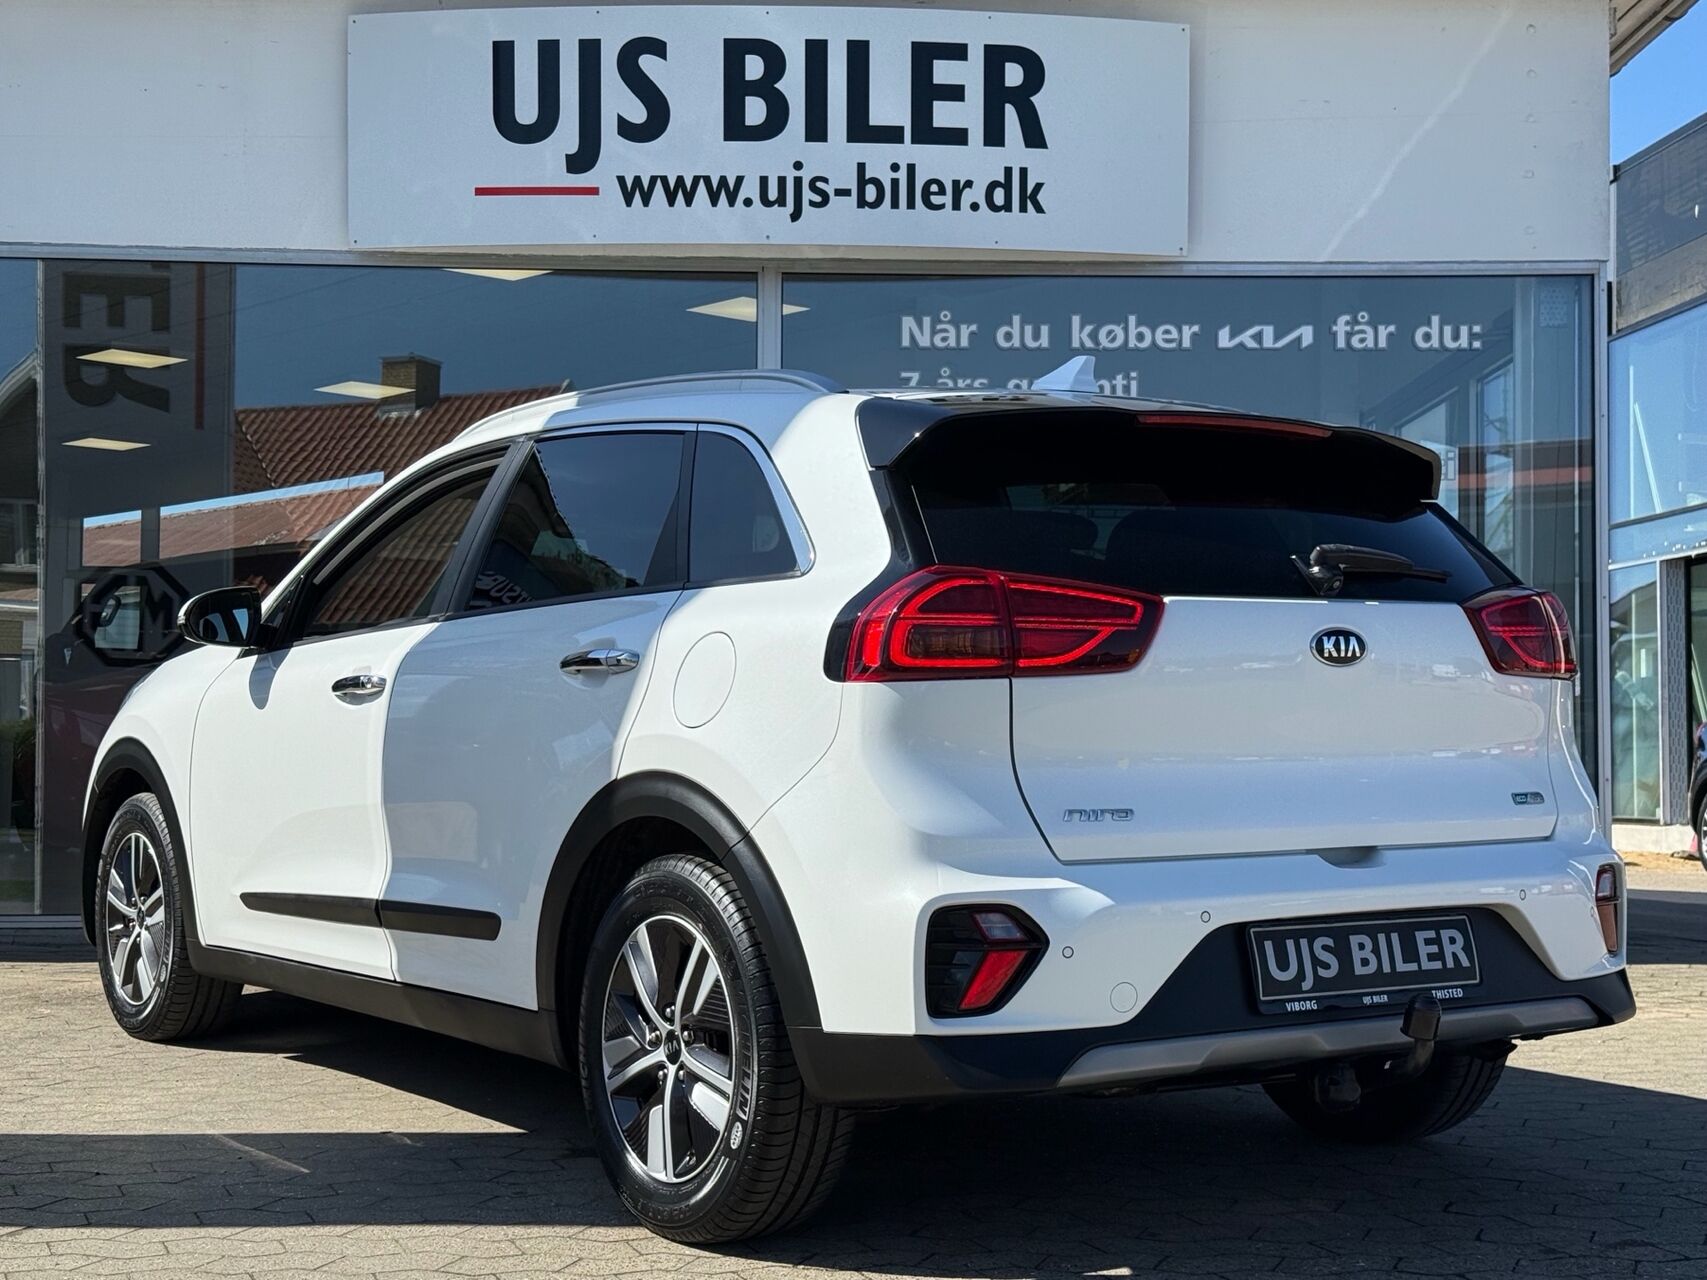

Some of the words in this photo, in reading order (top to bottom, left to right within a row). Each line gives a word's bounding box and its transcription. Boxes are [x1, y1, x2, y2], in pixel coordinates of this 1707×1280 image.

[492, 36, 671, 175] UJS
[723, 37, 1049, 150] BILER
[616, 160, 1046, 223] www.ujs-biler.dk
[900, 311, 977, 348] Når
[995, 315, 1049, 348] du
[1071, 315, 1199, 350] køber
[1217, 325, 1313, 349] KIA
[1332, 311, 1395, 349] får
[1414, 315, 1482, 349] du:
[1322, 636, 1361, 658] KIA
[1264, 937, 1340, 991] UJS
[1349, 928, 1471, 976] BILER
[1285, 1000, 1318, 1012] VIBORG
[1431, 988, 1463, 999] THISTED
